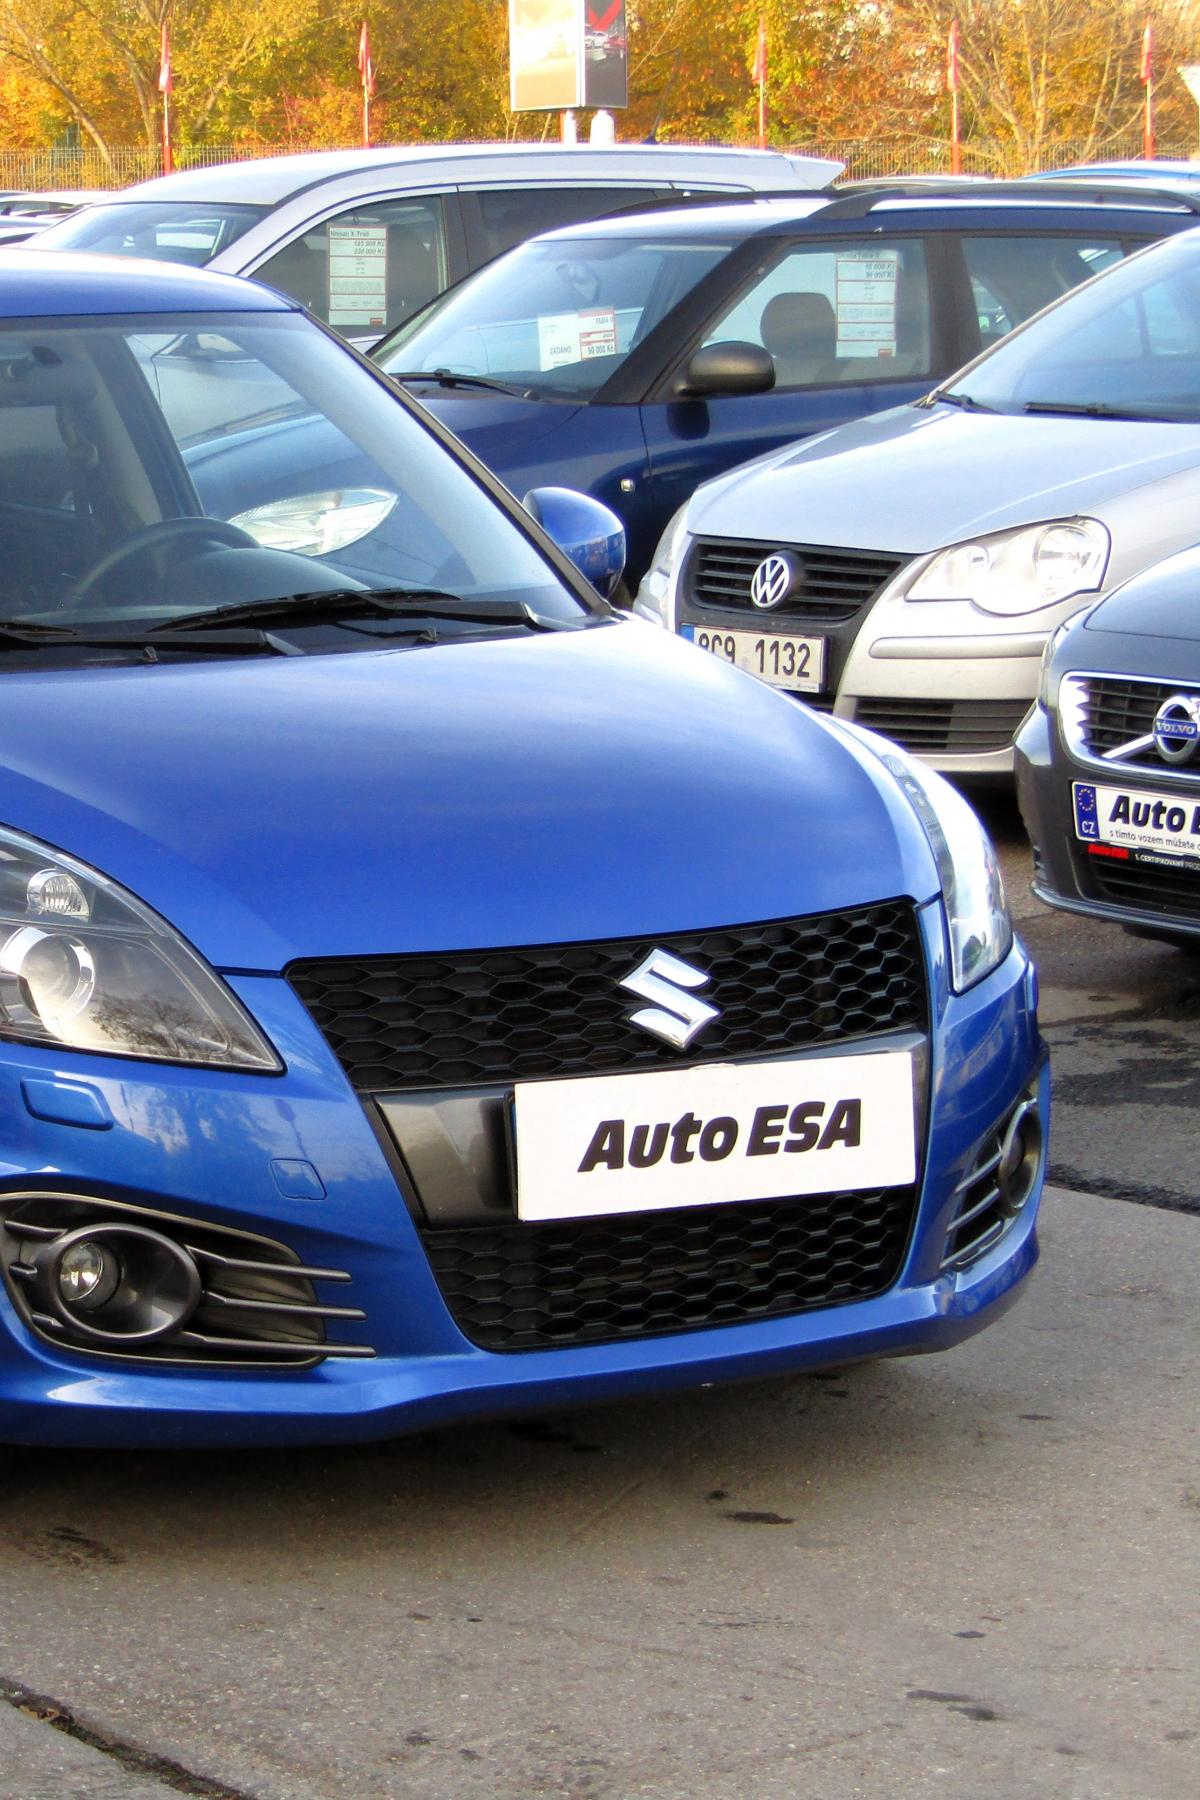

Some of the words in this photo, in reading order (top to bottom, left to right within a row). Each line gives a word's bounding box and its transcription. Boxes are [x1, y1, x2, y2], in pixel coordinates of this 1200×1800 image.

[755, 639, 810, 678] 1132
[1156, 721, 1195, 735] VOLVO
[1108, 795, 1186, 833] Auto
[1081, 821, 1096, 835] CZ
[1138, 834, 1164, 845] vozem
[576, 1112, 739, 1173] Auto
[746, 1098, 862, 1157] ESA
